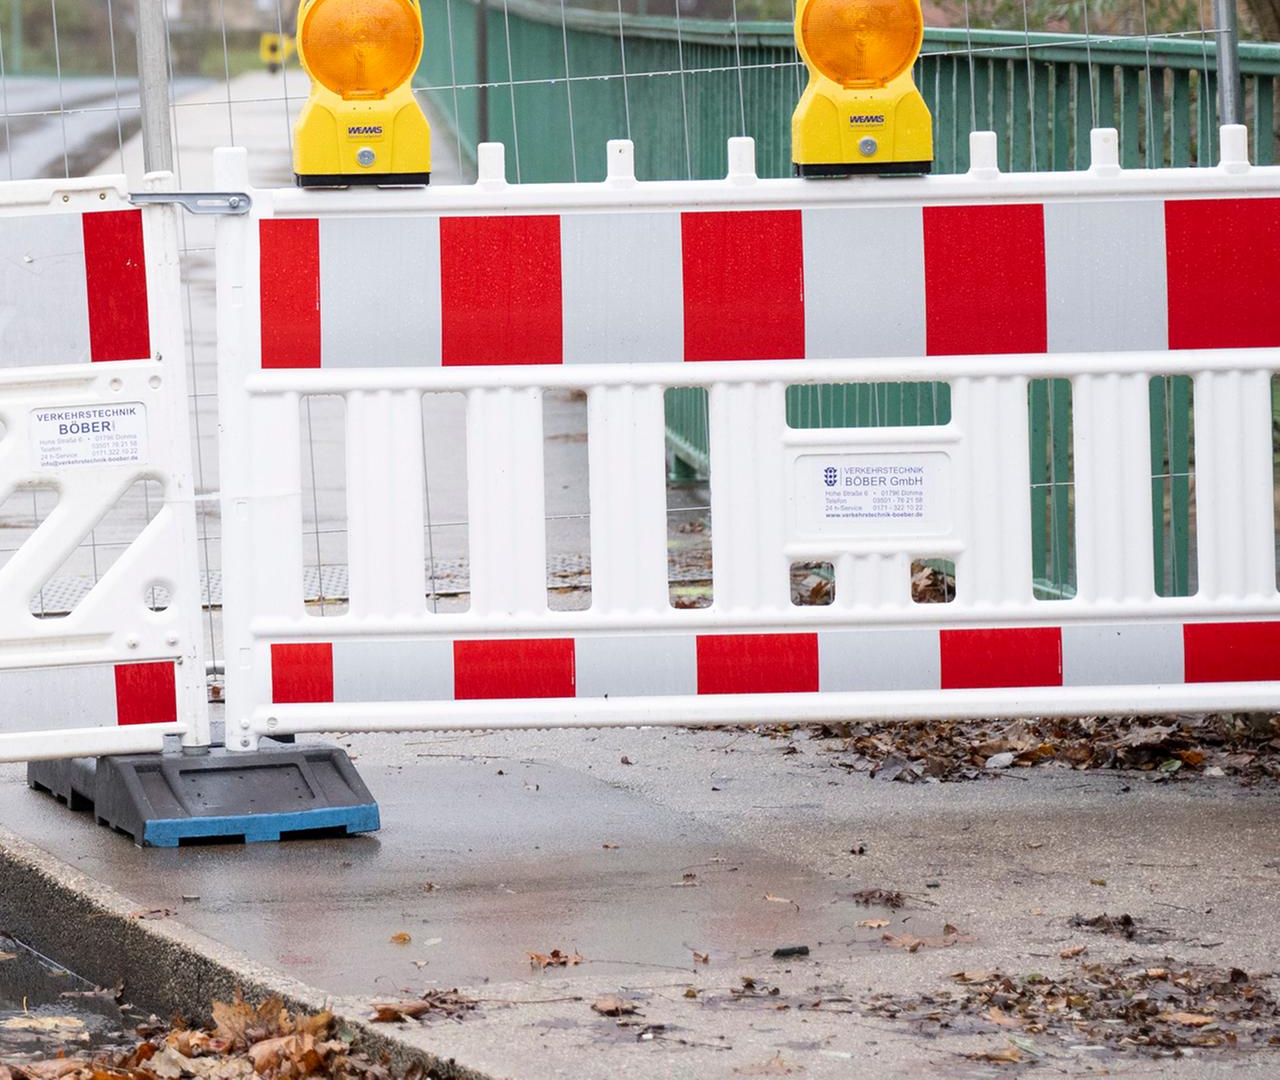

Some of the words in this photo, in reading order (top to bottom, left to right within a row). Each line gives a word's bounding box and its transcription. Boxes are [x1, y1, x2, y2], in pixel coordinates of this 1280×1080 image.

[850, 115, 884, 123] WEMAS
[348, 126, 383, 134] WEMAS
[36, 408, 136, 422] VERKEHRSTECHNIK
[58, 420, 111, 435] BÖBER
[844, 466, 924, 474] VERKEHRSTECHNIK
[845, 475, 887, 487] BÖBER
[890, 476, 923, 486] GmbH
